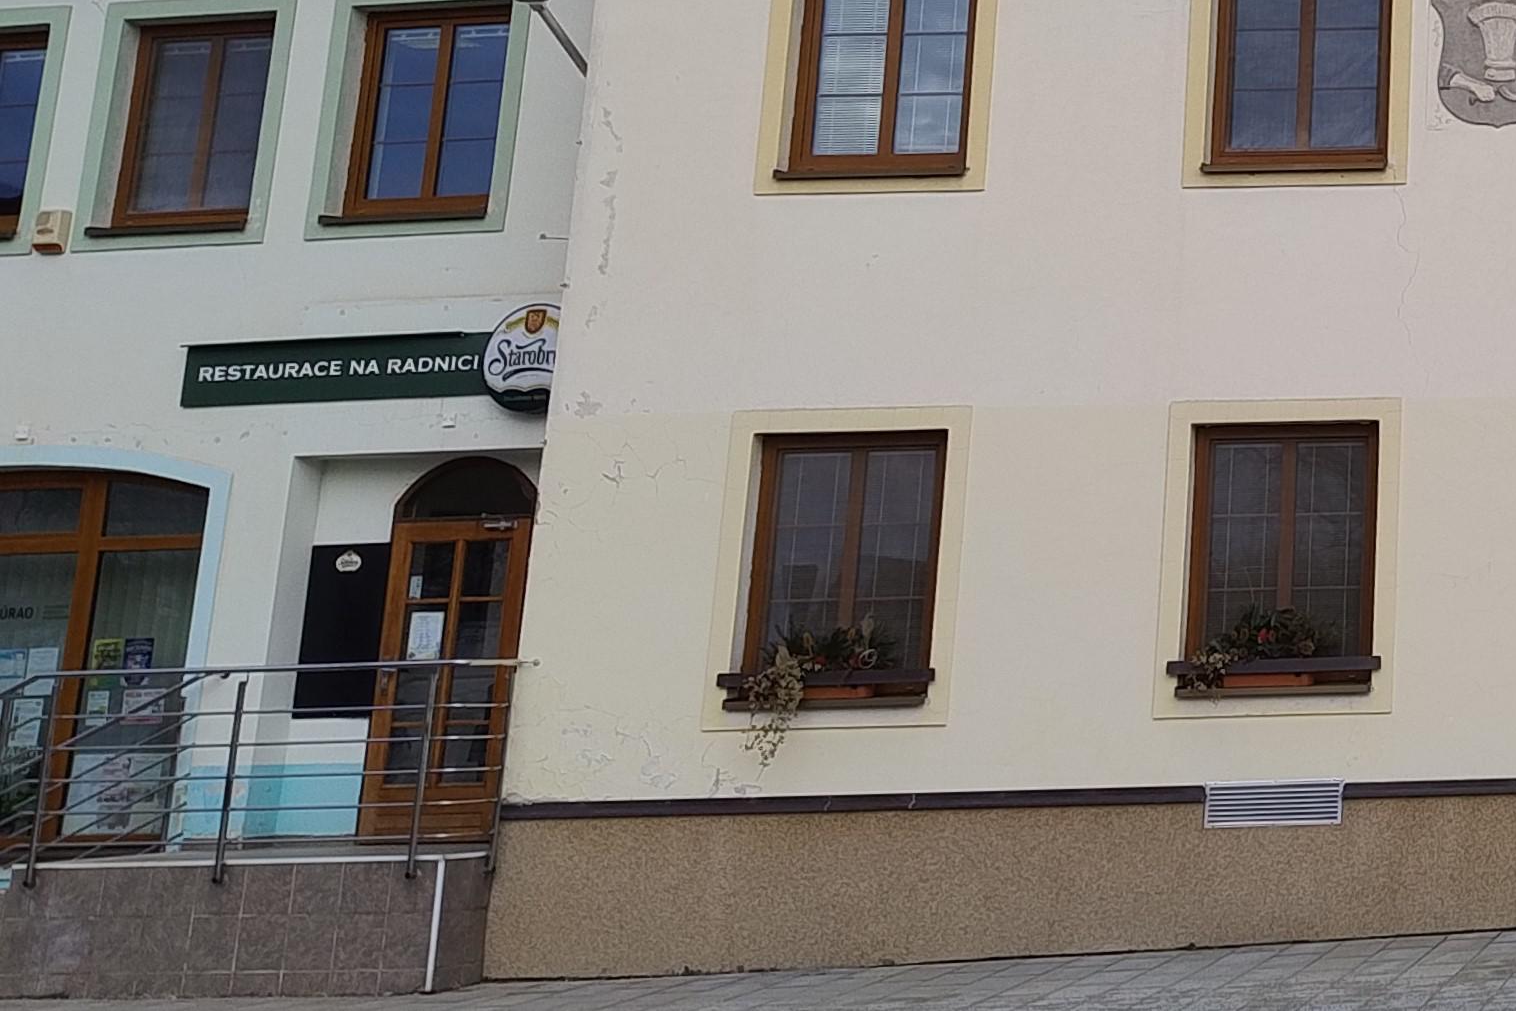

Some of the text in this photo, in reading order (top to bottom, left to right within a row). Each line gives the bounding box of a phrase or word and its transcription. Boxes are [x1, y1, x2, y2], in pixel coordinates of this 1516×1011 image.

[198, 355, 480, 382] RESTAURACE NA RADNICI
